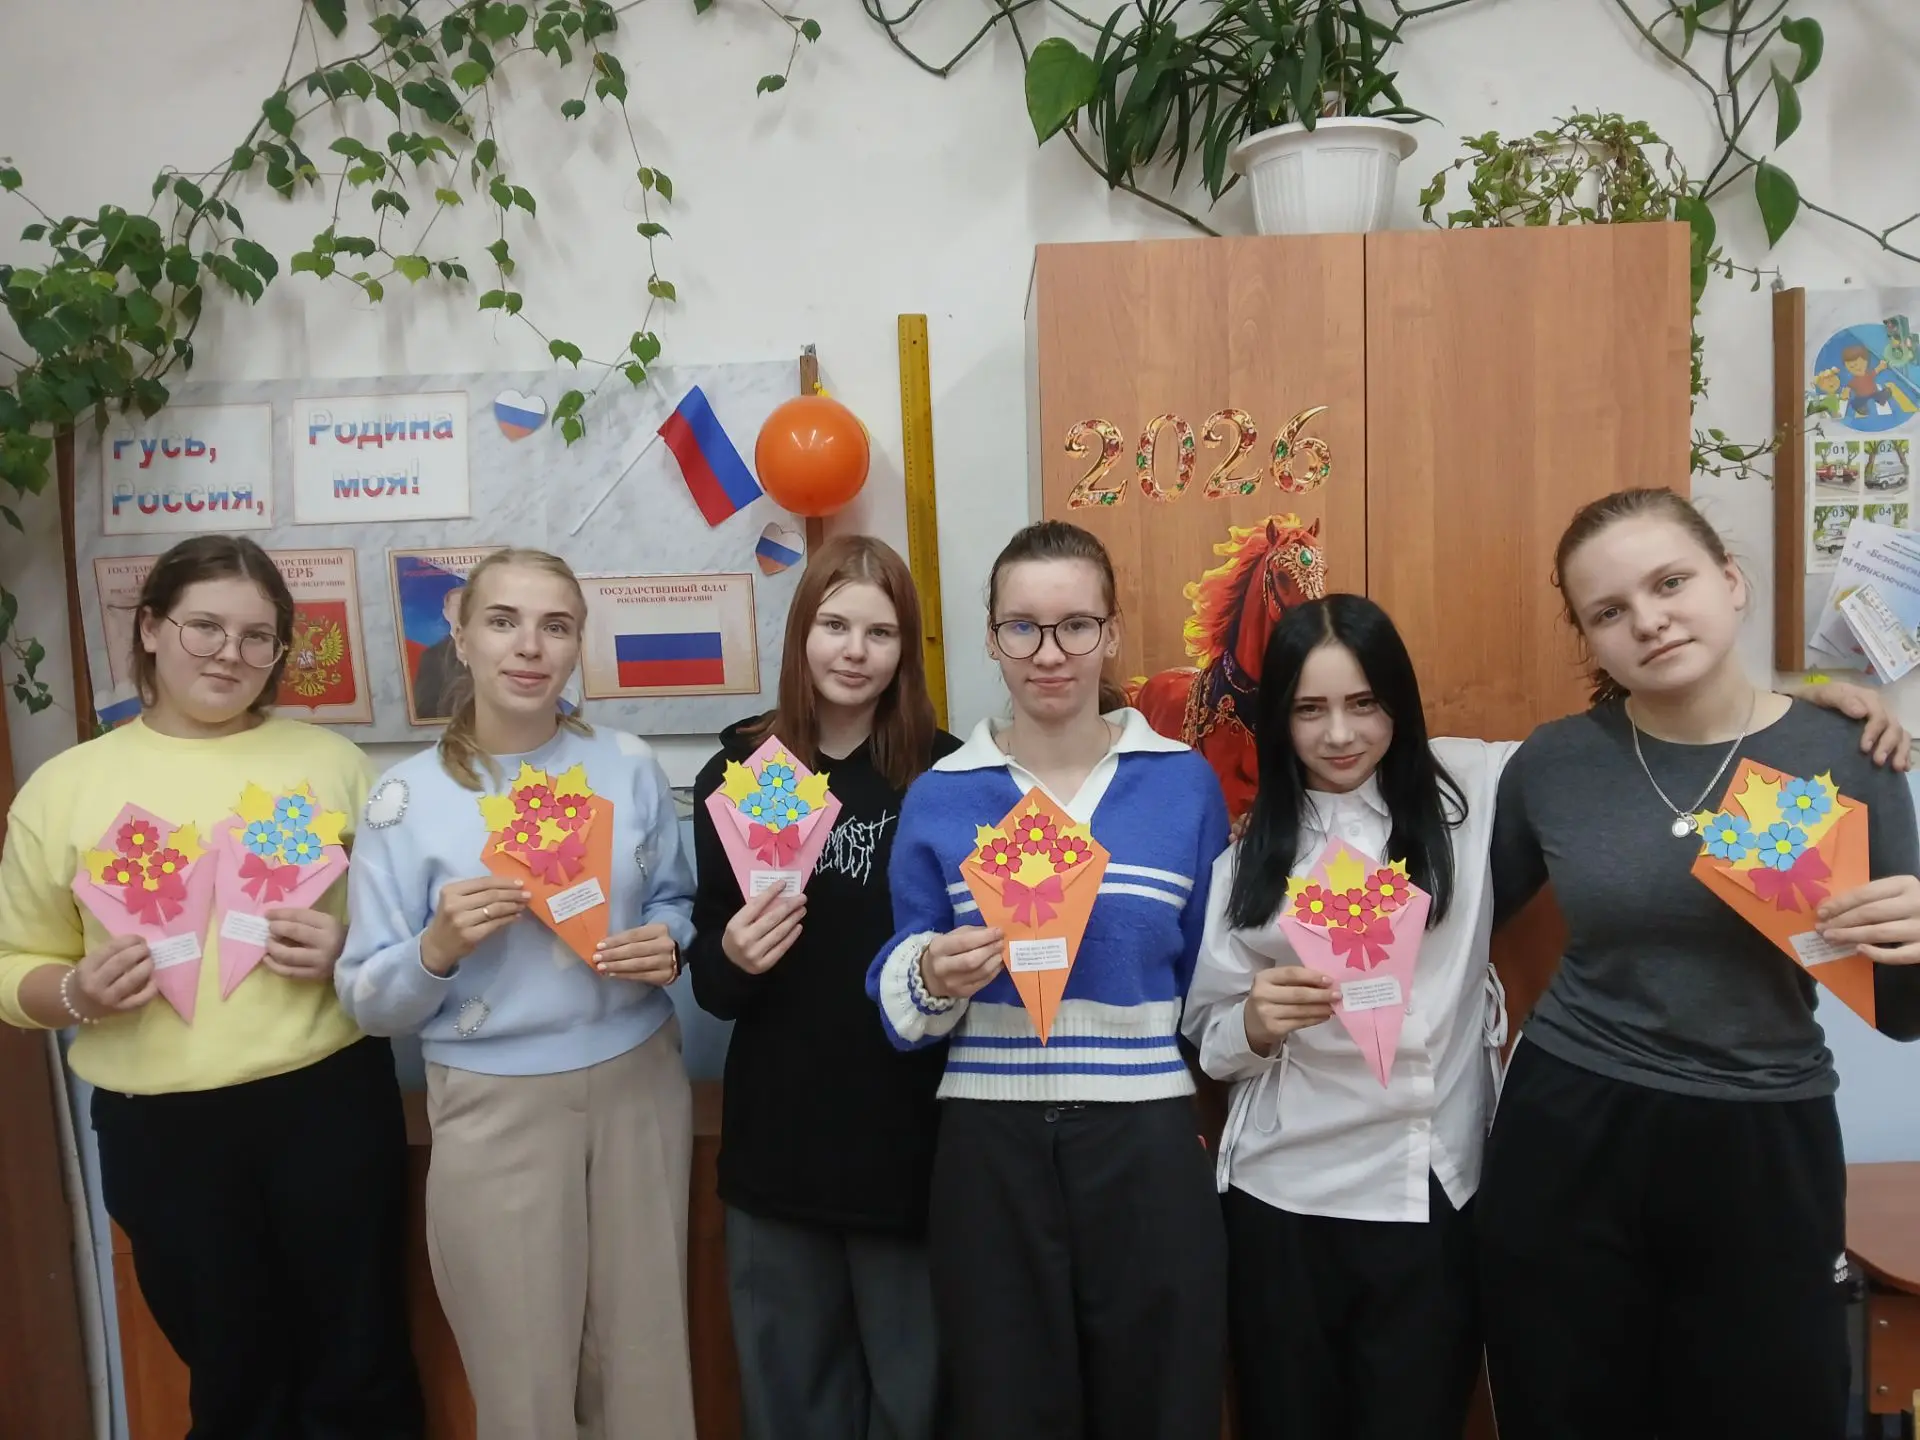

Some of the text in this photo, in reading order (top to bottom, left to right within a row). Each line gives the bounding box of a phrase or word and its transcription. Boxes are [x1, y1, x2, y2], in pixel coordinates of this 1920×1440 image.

[308, 409, 454, 450] Родина
[113, 427, 216, 469] Русь,
[1064, 405, 1332, 511] 2026
[1832, 446, 1845, 455] 01
[1880, 443, 1892, 453] 02
[333, 456, 420, 498] моя!
[112, 478, 264, 516] Россия,
[1832, 508, 1845, 518] 03
[1879, 507, 1892, 517] 04
[599, 583, 729, 596] ГОСУДАРСТВЕННЫЙ ФЛАГ
